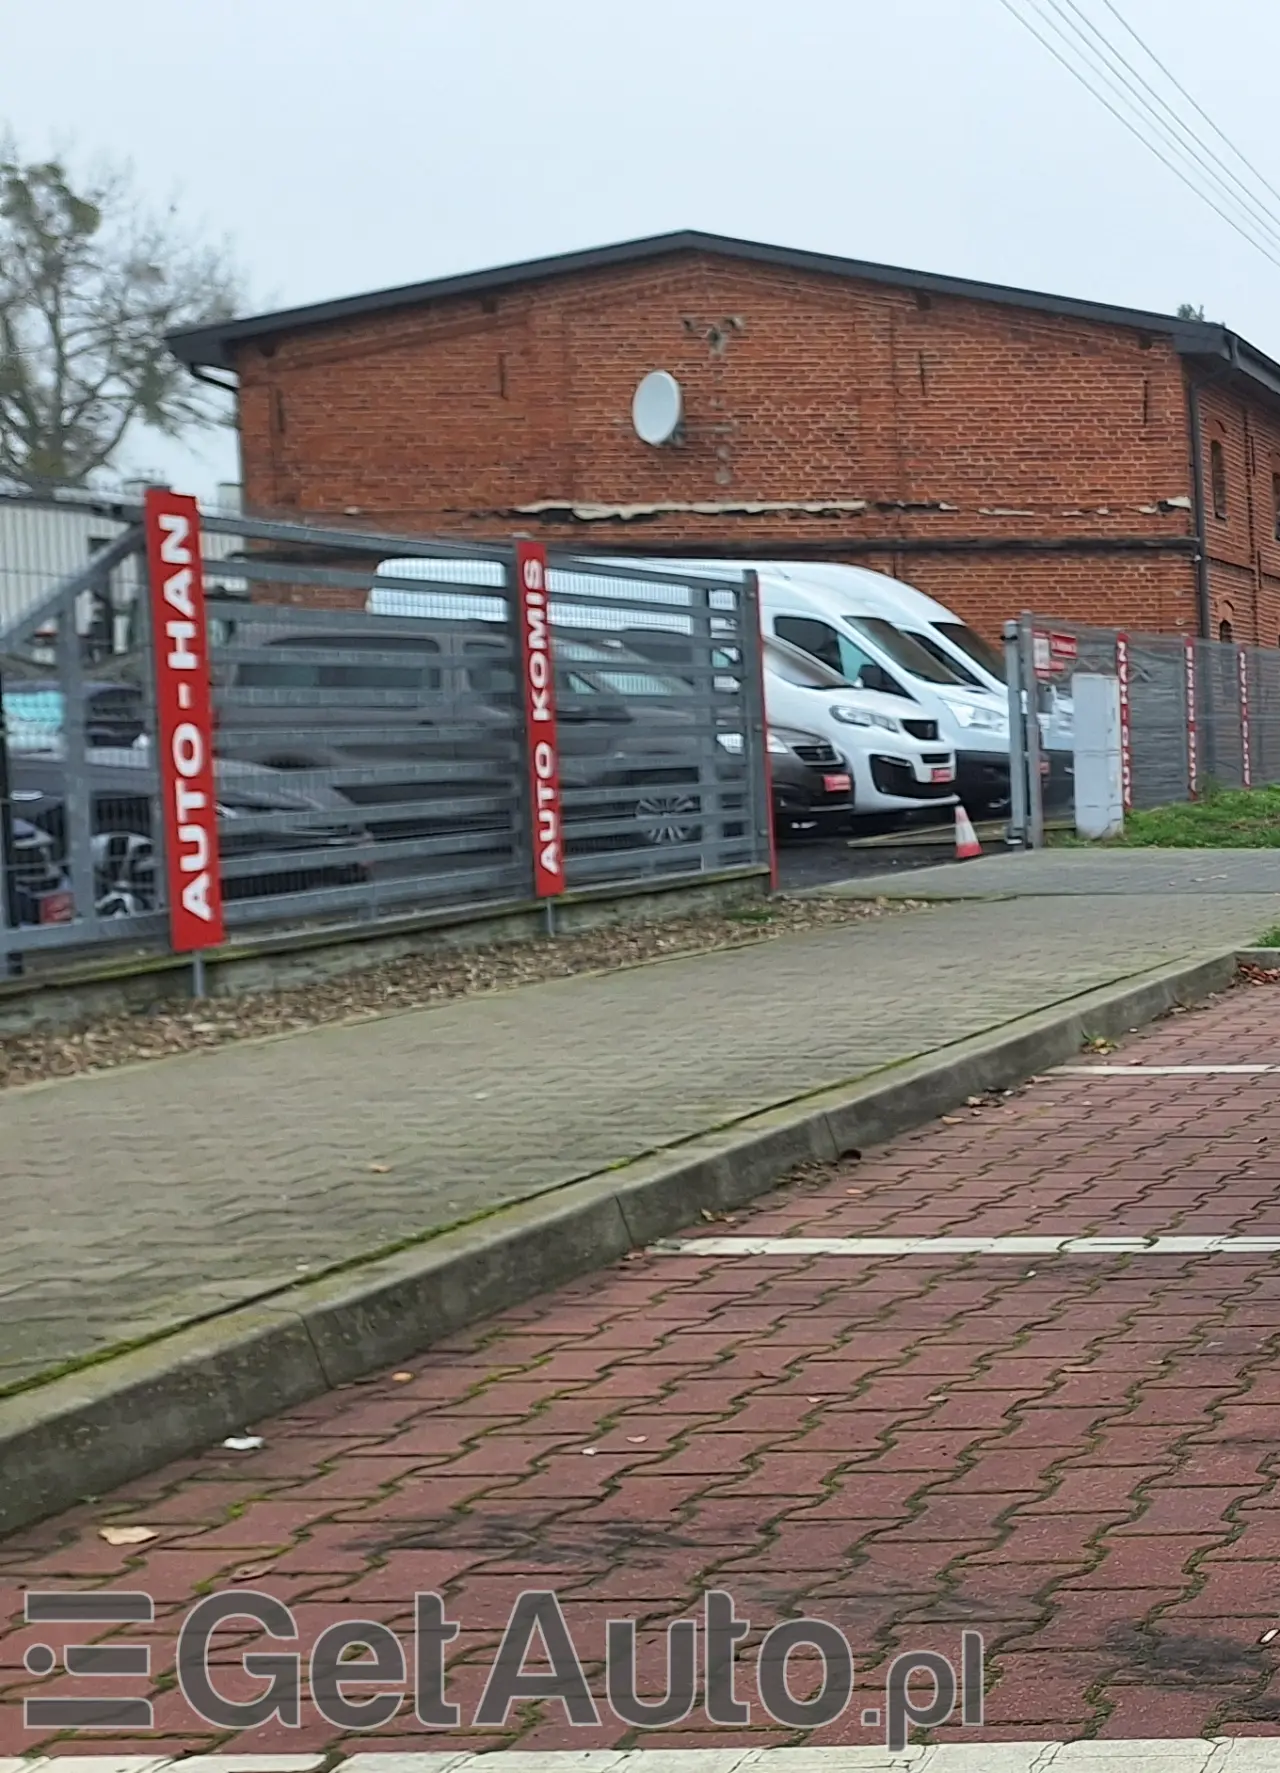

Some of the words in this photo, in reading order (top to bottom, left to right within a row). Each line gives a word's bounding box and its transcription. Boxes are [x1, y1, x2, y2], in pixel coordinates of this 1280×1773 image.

[158, 513, 199, 670] HAN
[523, 558, 551, 721] KOMIS
[172, 722, 212, 922] AUTO
[534, 740, 560, 875] AUTO
